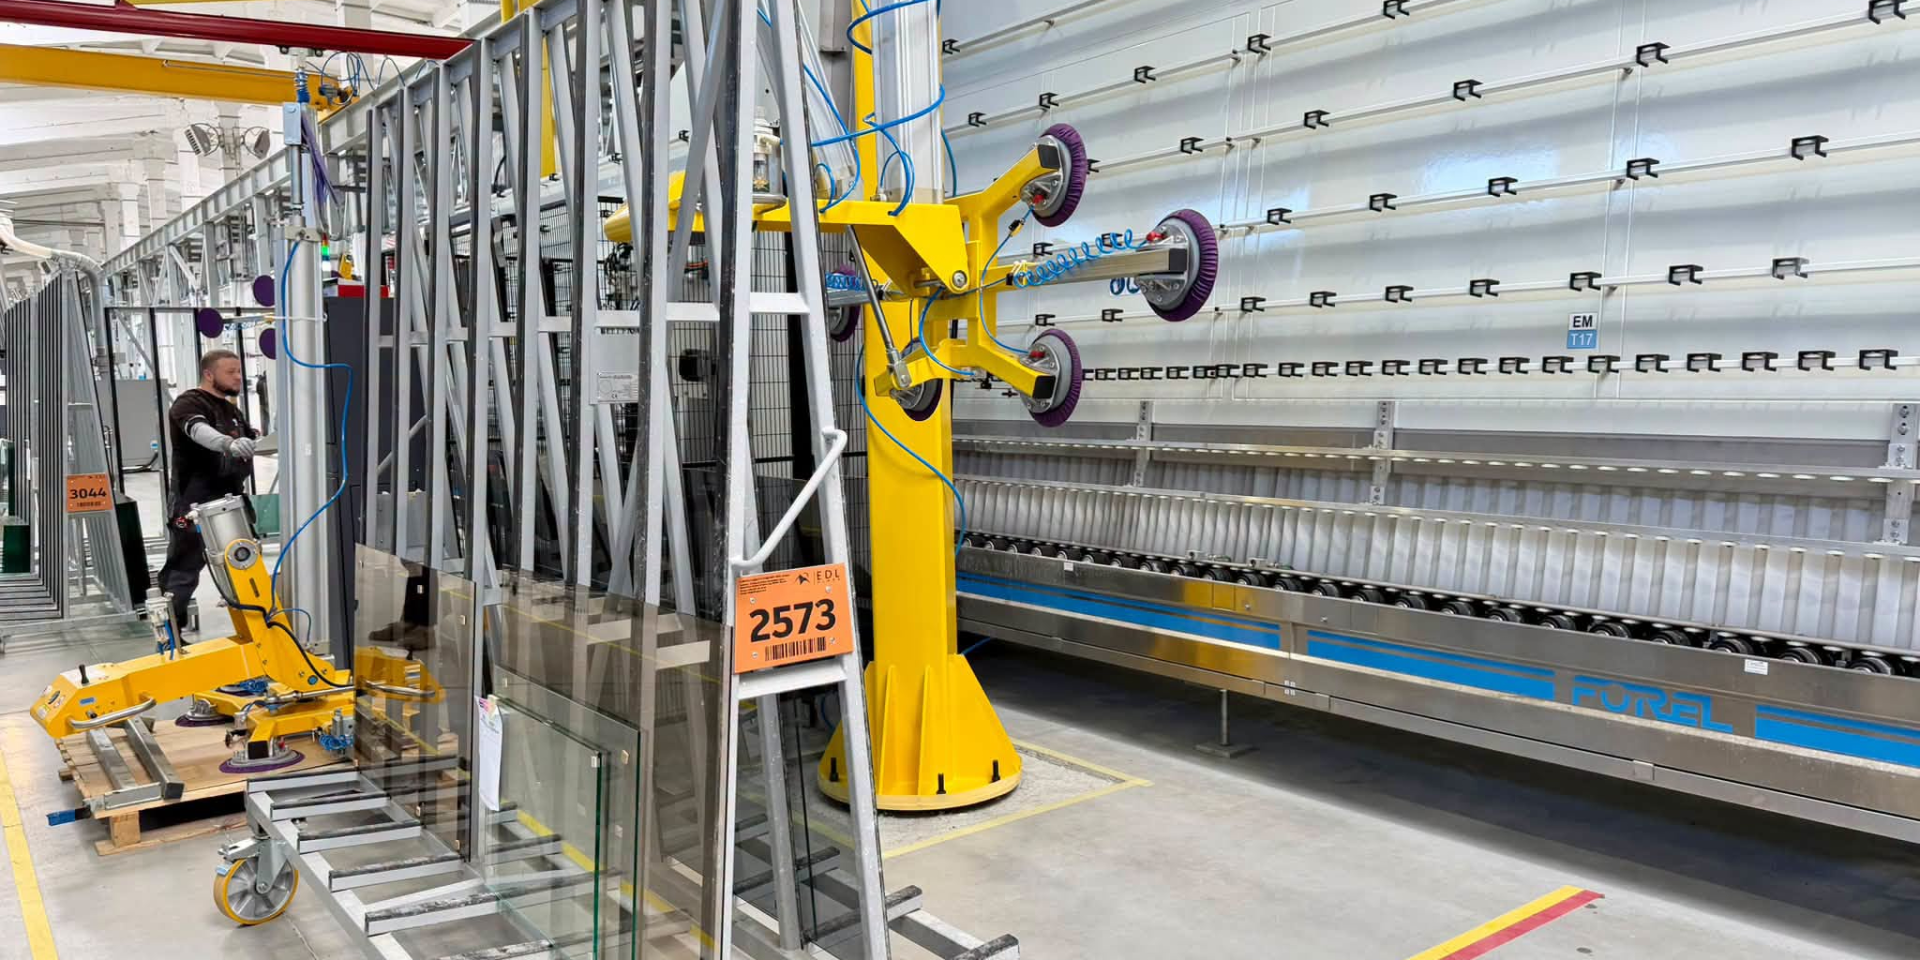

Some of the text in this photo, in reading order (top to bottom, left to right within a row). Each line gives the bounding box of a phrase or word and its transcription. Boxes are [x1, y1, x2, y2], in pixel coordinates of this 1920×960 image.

[1573, 315, 1592, 328] EM
[1571, 333, 1593, 346] T17
[69, 487, 107, 499] 3044
[816, 569, 840, 581] EDL
[749, 599, 836, 642] 2573
[1572, 675, 1733, 734] FOREL
